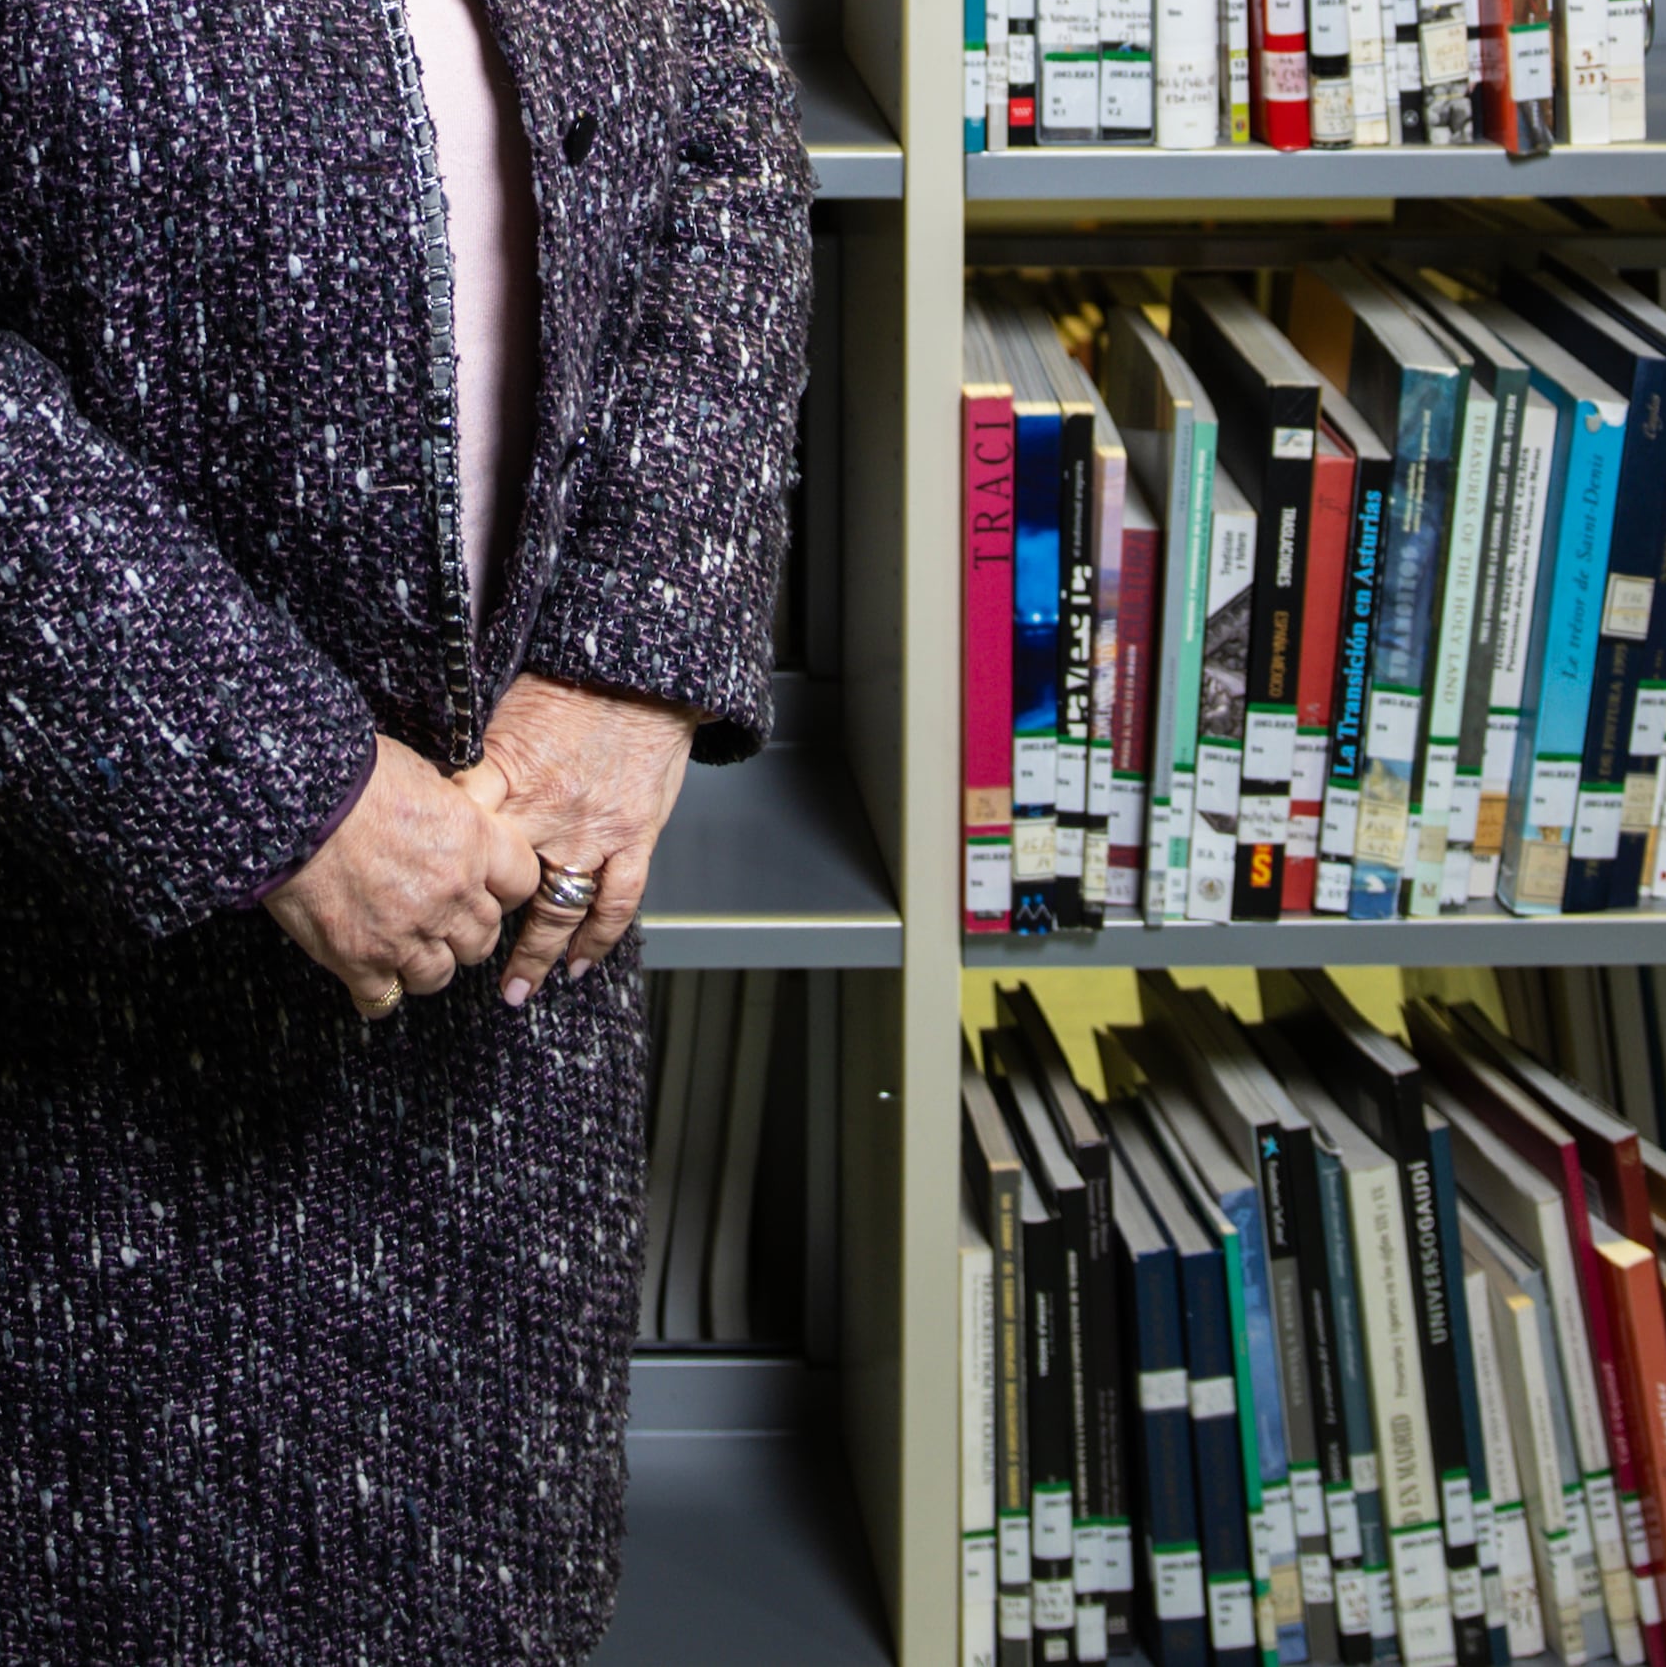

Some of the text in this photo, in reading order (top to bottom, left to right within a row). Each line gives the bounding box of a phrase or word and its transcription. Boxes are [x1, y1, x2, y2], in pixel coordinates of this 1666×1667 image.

[1460, 522, 1476, 544] OF
[1456, 556, 1472, 588] THE
[1571, 568, 1590, 591] de
[1332, 488, 1383, 775] La Transición en Asturias
[1449, 596, 1467, 643] HOLY
[1443, 653, 1461, 704] LAND
